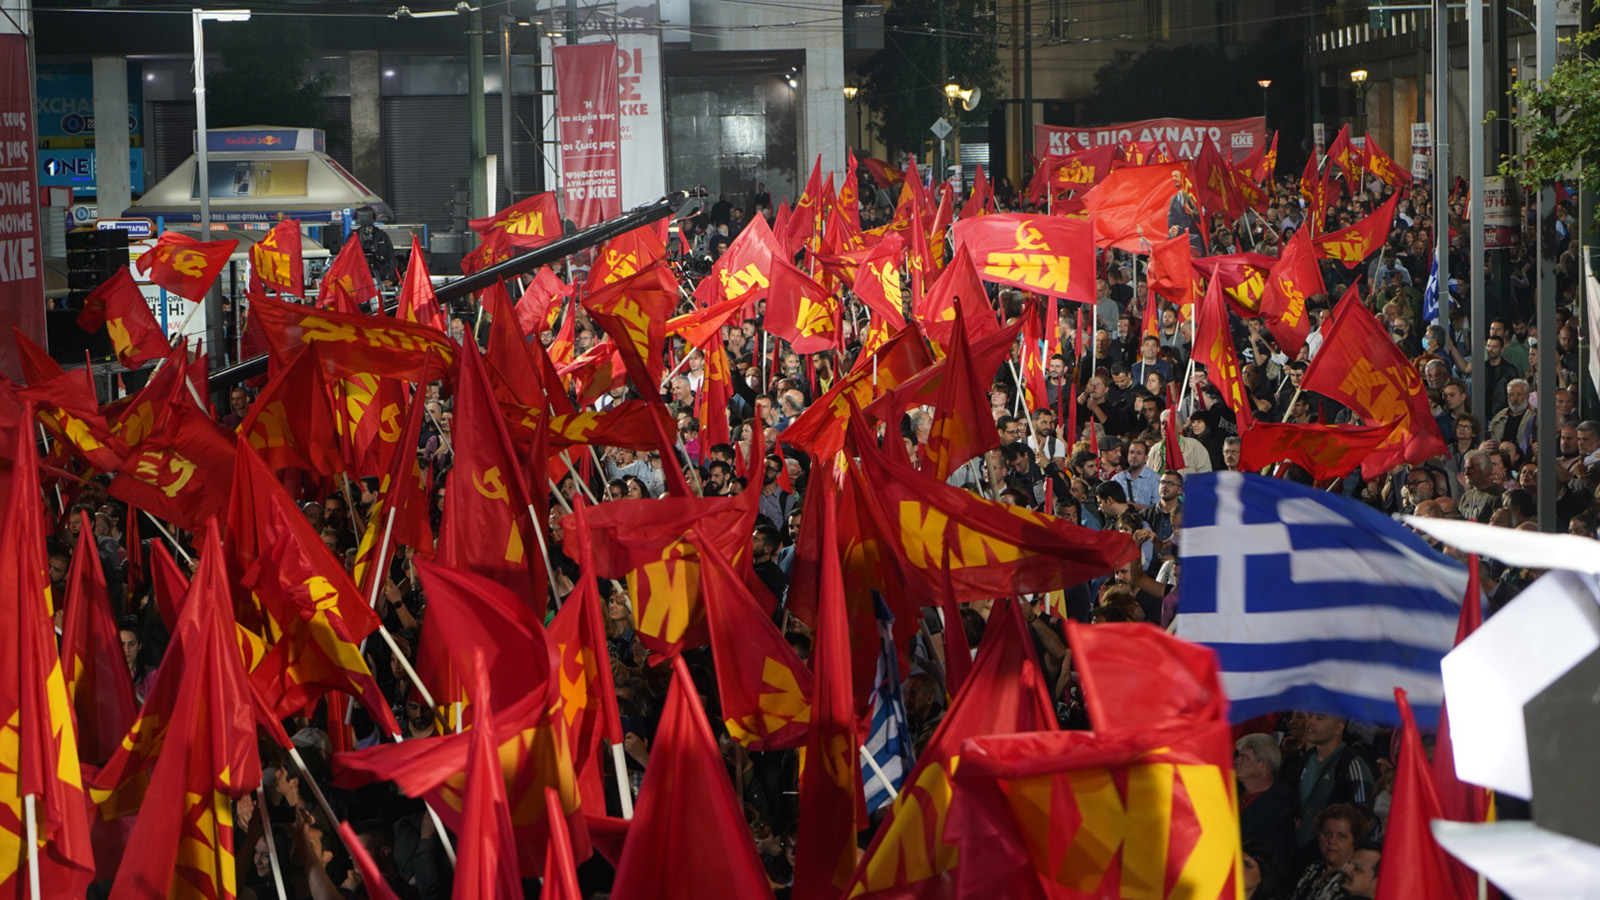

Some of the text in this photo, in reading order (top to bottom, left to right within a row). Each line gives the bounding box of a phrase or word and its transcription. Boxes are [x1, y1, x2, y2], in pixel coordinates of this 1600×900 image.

[1140, 126, 1221, 142] ΔΥΝΑΤΟ
[1231, 134, 1254, 145] ΚΚΕ
[566, 186, 617, 201] ΤΟ ΚΚΕ
